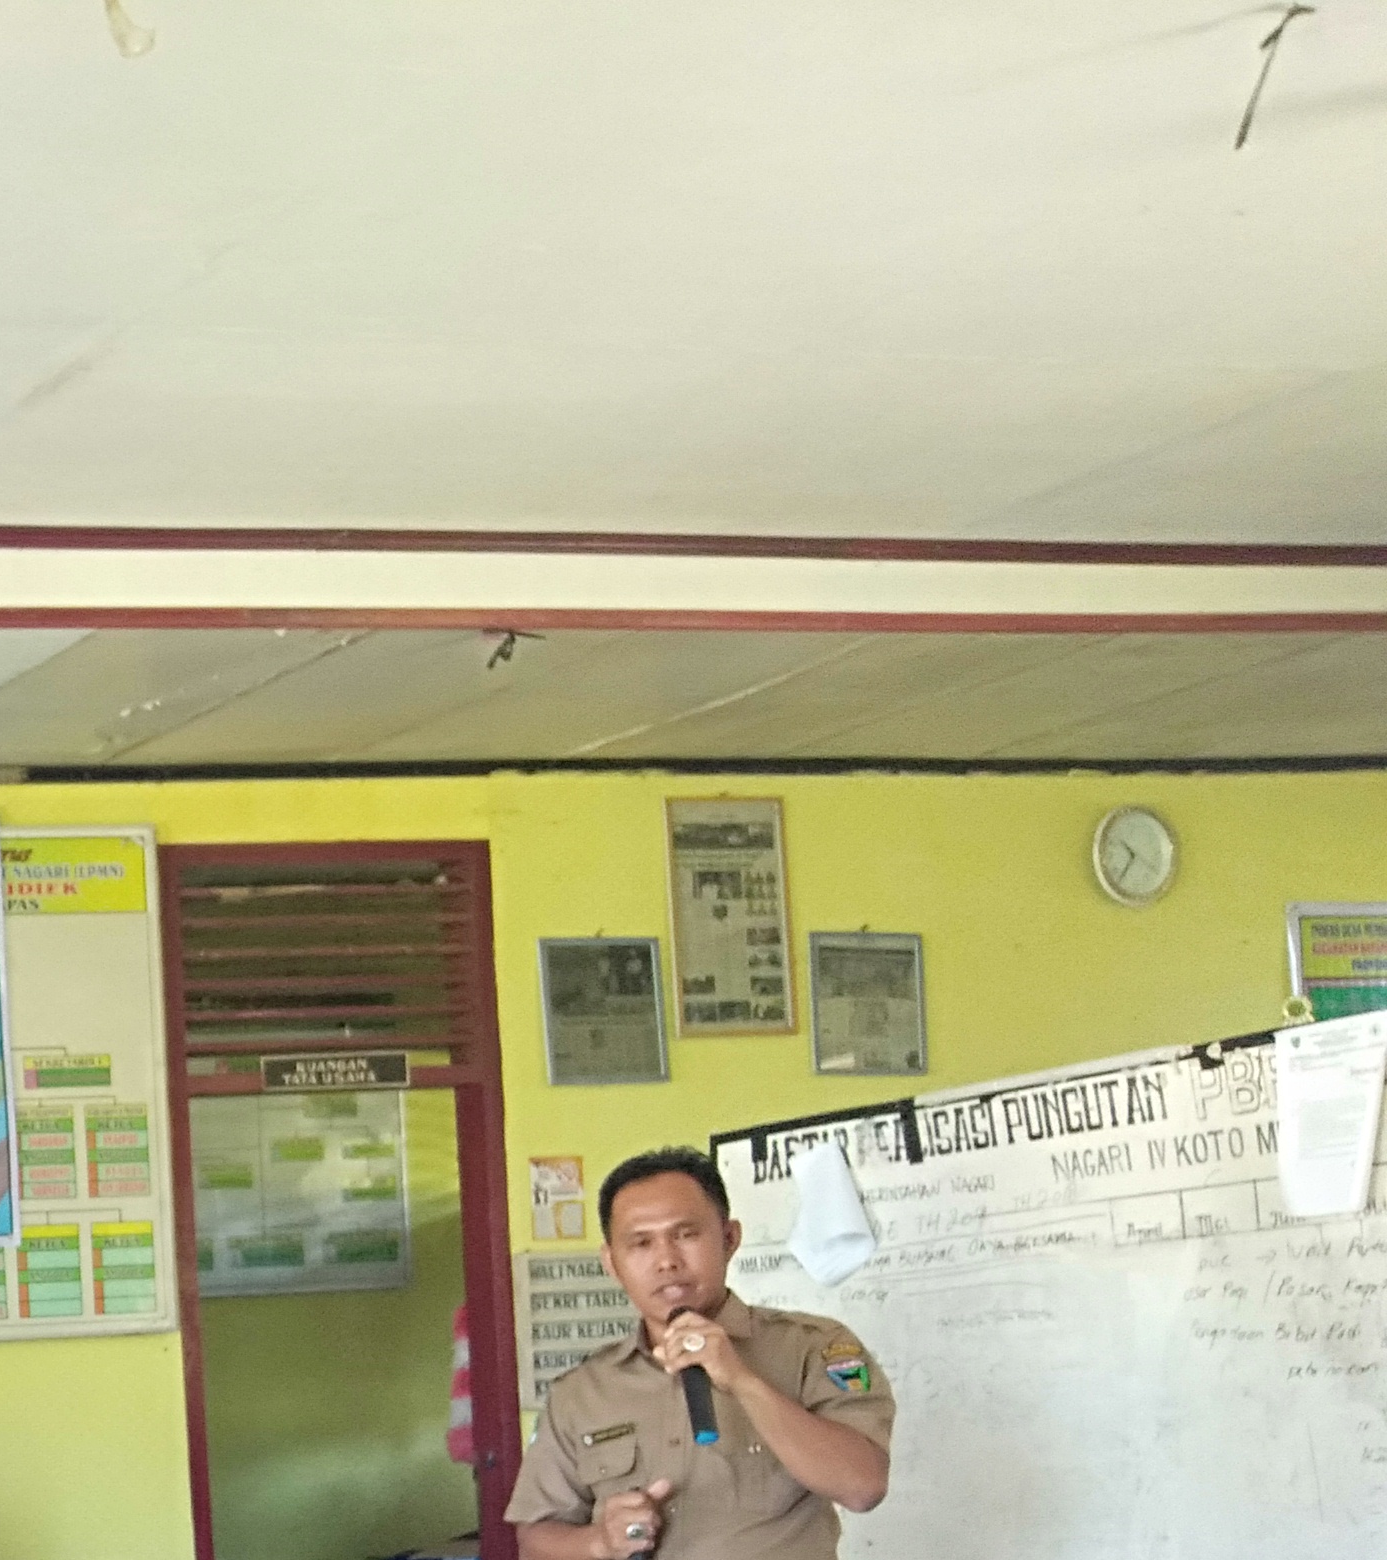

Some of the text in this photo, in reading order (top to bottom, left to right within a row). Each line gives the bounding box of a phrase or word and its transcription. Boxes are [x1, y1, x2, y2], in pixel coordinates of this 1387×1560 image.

[1003, 1071, 1169, 1145] PUNGUTAN
[1052, 1142, 1133, 1184] NAGARI
[1147, 1139, 1167, 1171] IV
[1175, 1126, 1245, 1167] KOTO
